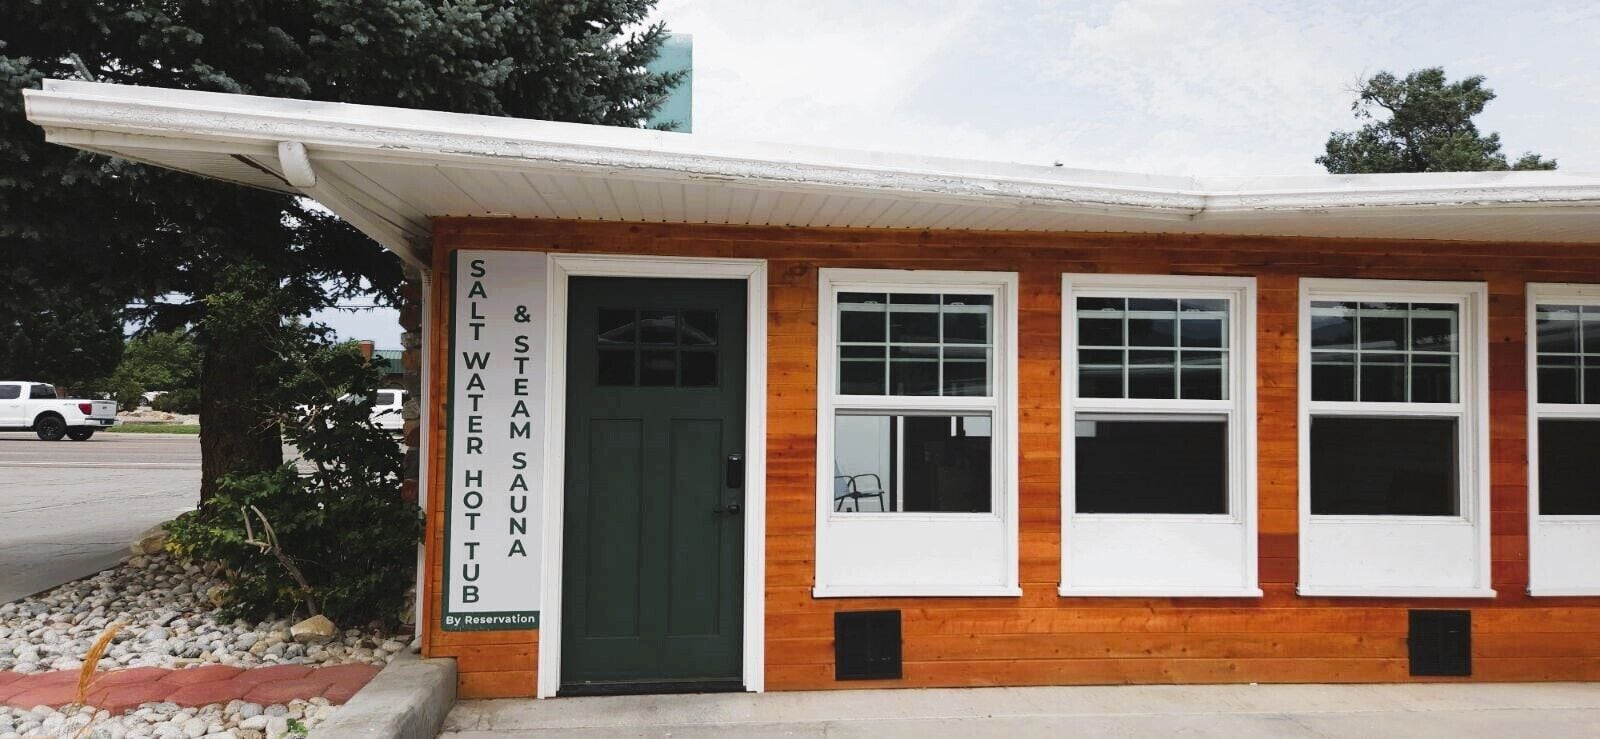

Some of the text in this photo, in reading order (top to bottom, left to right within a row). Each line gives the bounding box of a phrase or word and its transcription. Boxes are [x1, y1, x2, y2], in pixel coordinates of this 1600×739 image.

[462, 259, 490, 604] SALT WATER HOT TUB
[507, 304, 531, 557] & STEAM SAUNA
[446, 614, 535, 626] By Reservation
